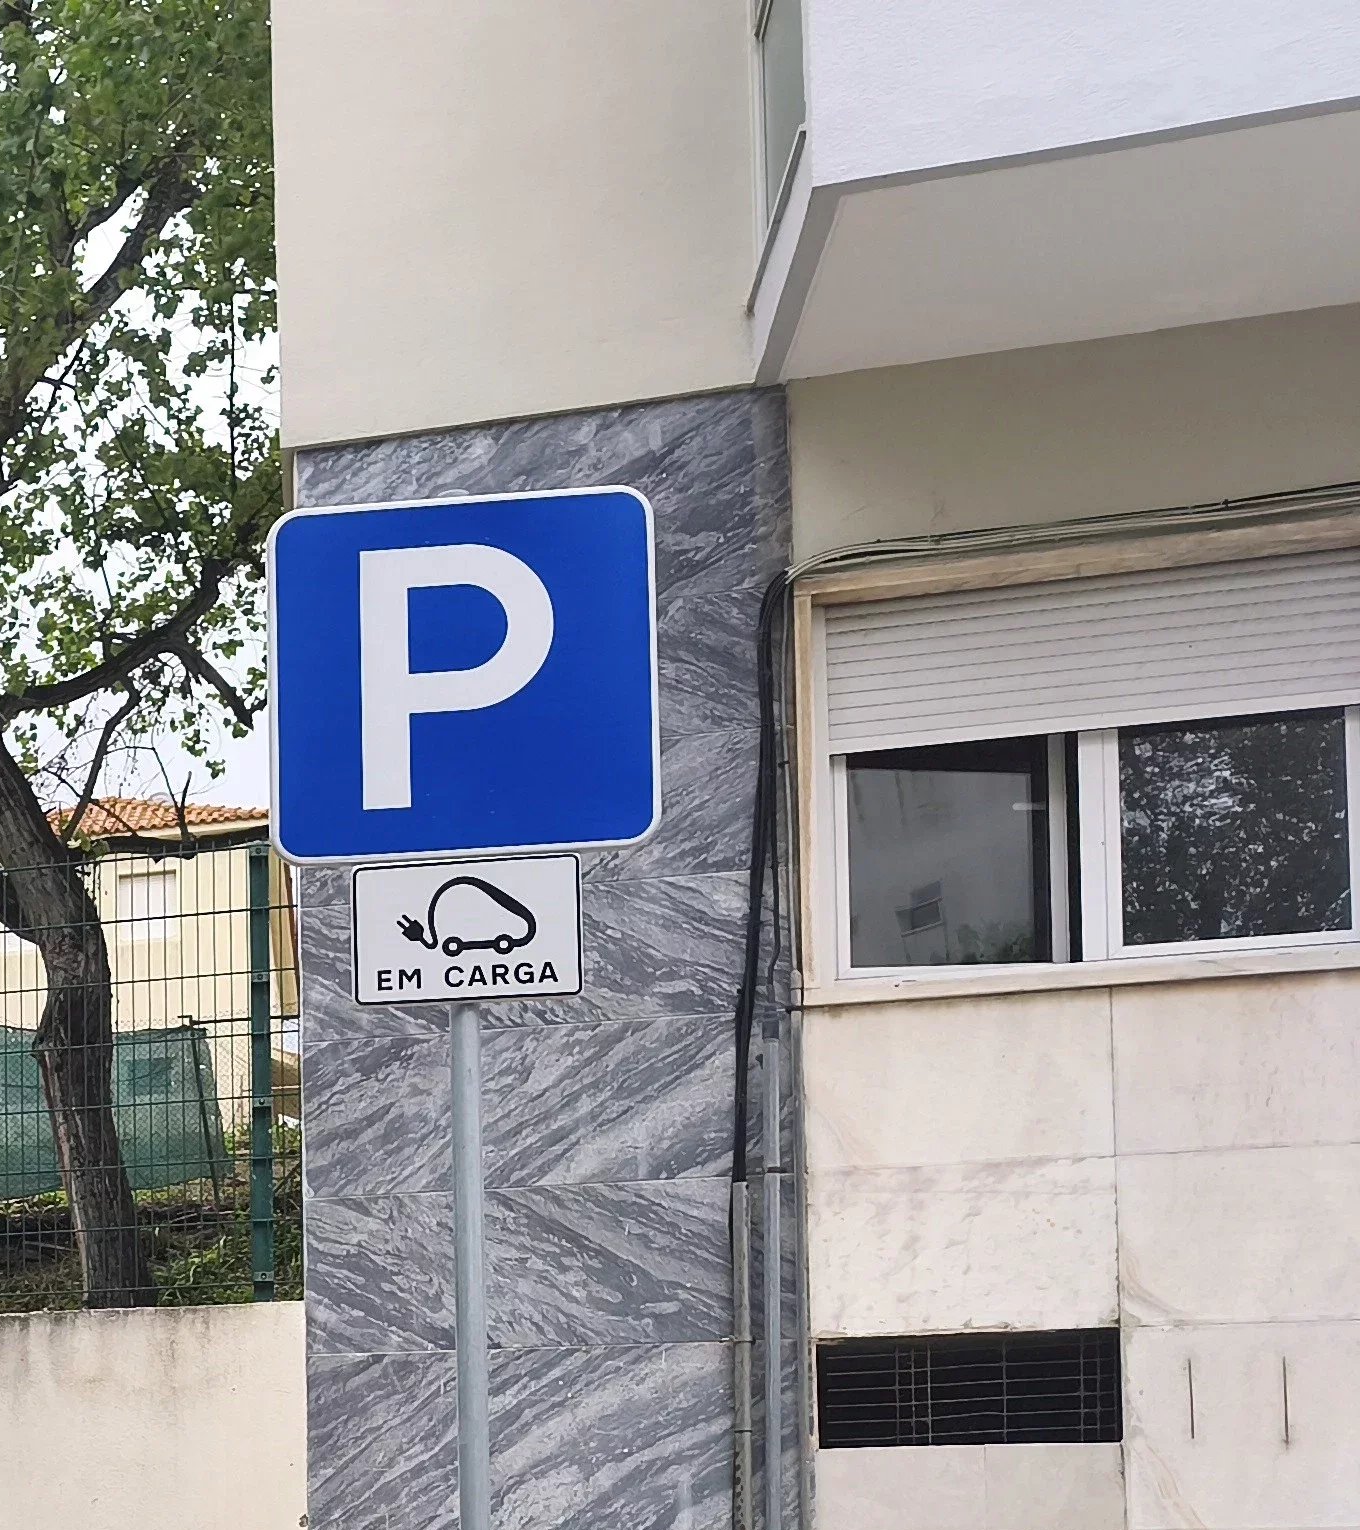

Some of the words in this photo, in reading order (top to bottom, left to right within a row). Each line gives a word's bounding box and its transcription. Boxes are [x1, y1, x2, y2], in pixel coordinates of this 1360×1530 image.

[360, 543, 554, 811] P
[377, 967, 423, 991] EM
[444, 961, 559, 988] CARGA
